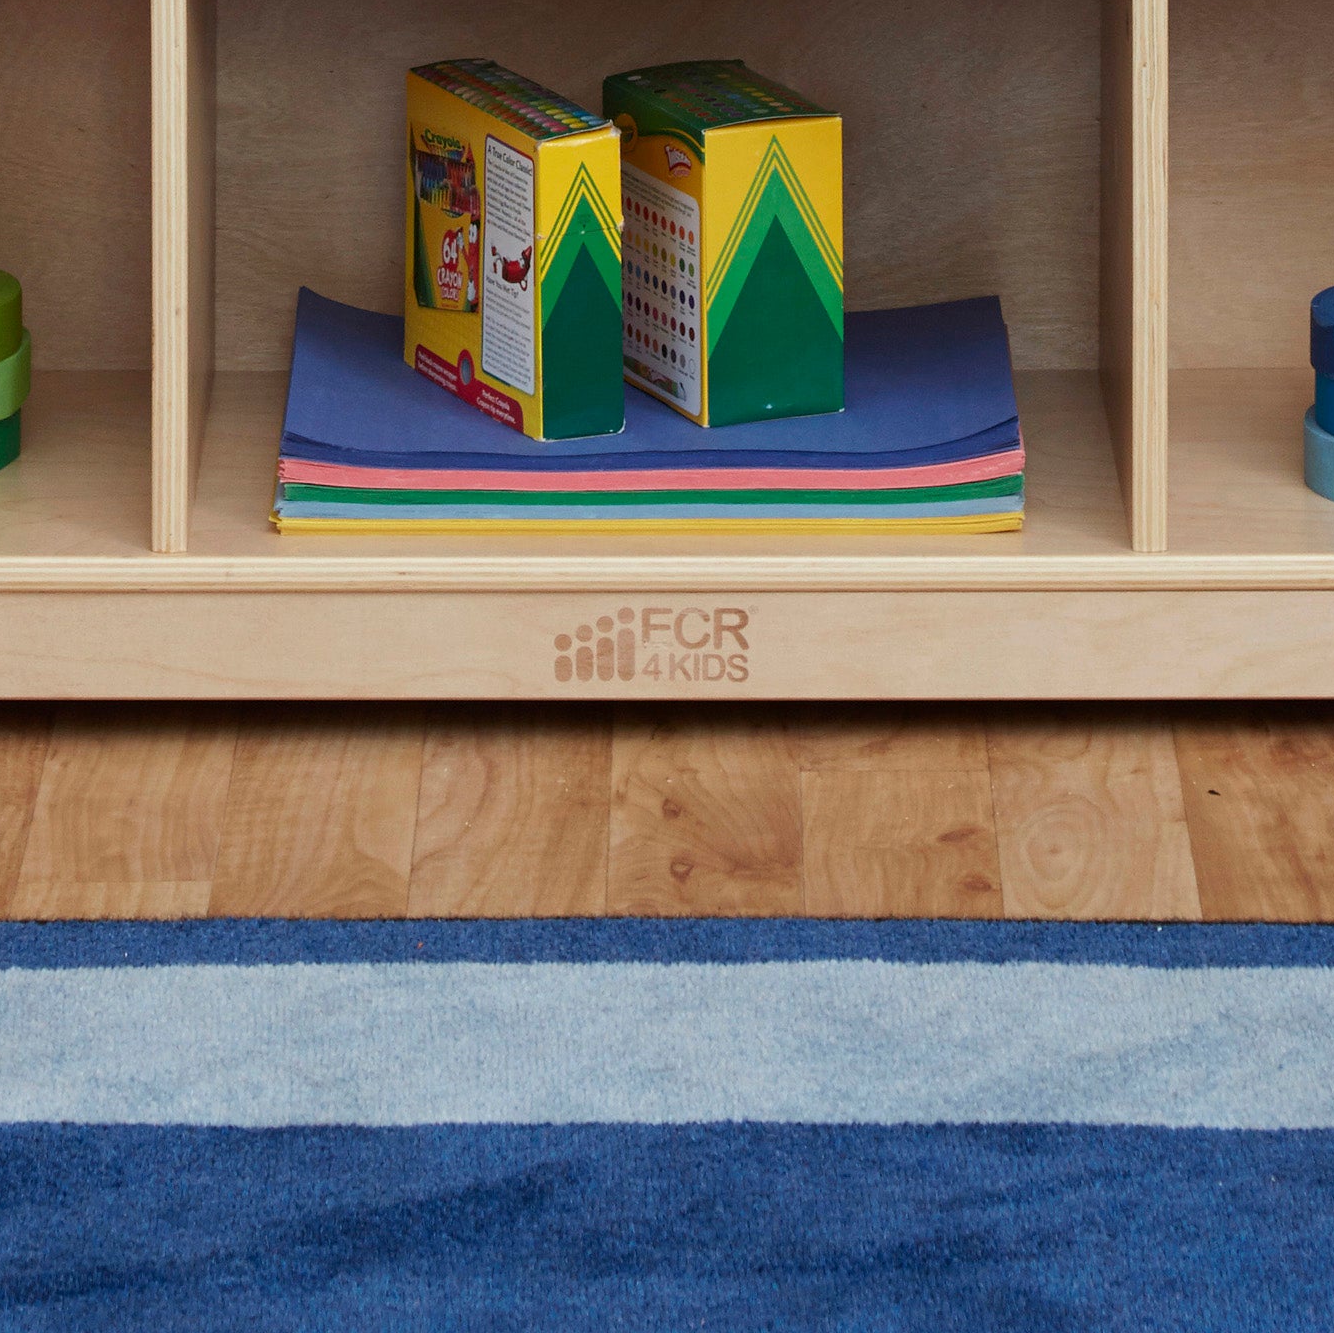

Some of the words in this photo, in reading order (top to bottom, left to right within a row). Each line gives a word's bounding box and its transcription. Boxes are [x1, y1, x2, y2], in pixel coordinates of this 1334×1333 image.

[423, 127, 463, 151] Crayola
[443, 235, 458, 265] 64
[436, 266, 464, 290] CRAYON
[641, 606, 750, 651] FCR
[641, 652, 664, 682] 4
[668, 652, 750, 683] KIDS
